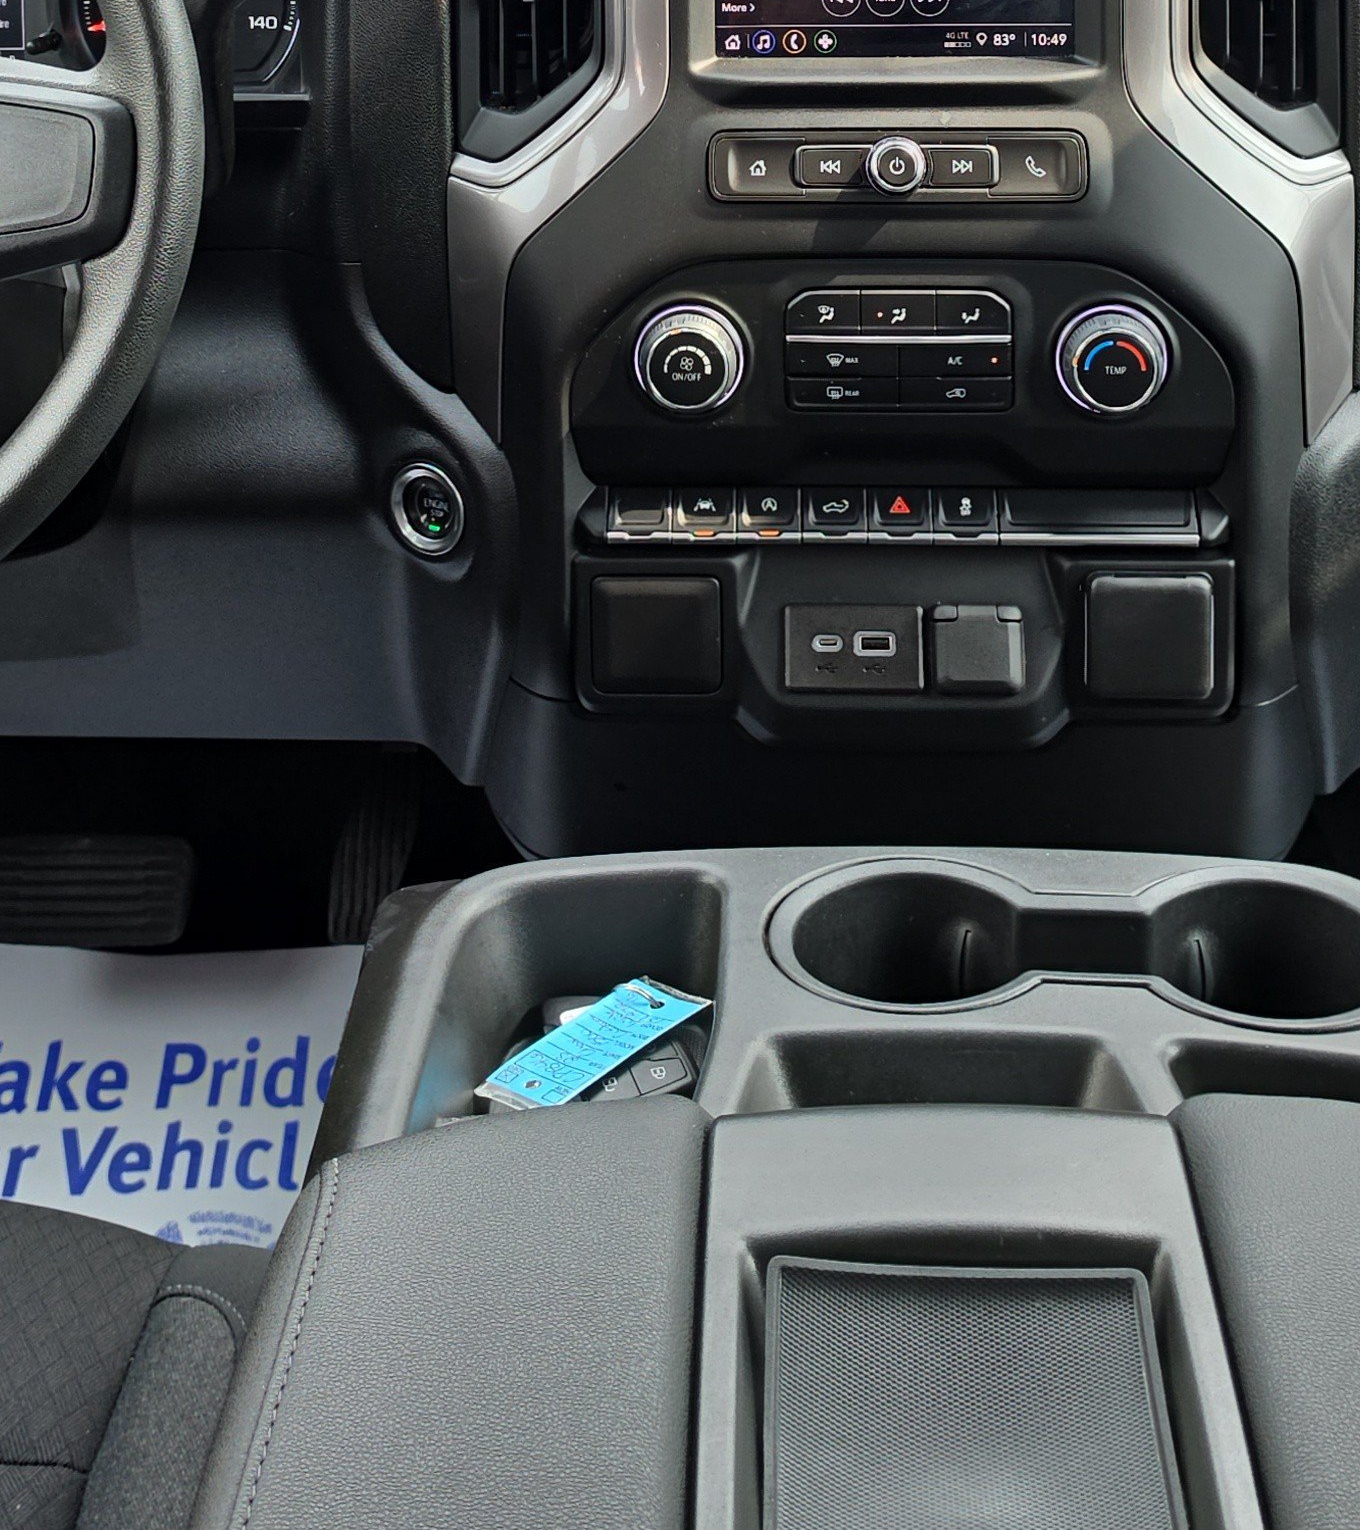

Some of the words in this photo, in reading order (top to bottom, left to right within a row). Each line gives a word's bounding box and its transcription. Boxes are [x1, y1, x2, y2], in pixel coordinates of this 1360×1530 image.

[722, 2, 747, 12] More
[248, 16, 277, 29] 140
[993, 34, 1016, 46] 83°
[1031, 34, 1067, 46] 10:49
[947, 354, 963, 366] A/C
[1105, 366, 1127, 375] TEMP
[672, 373, 701, 381] ON/OFF
[60, 1119, 300, 1197] Vehicl
